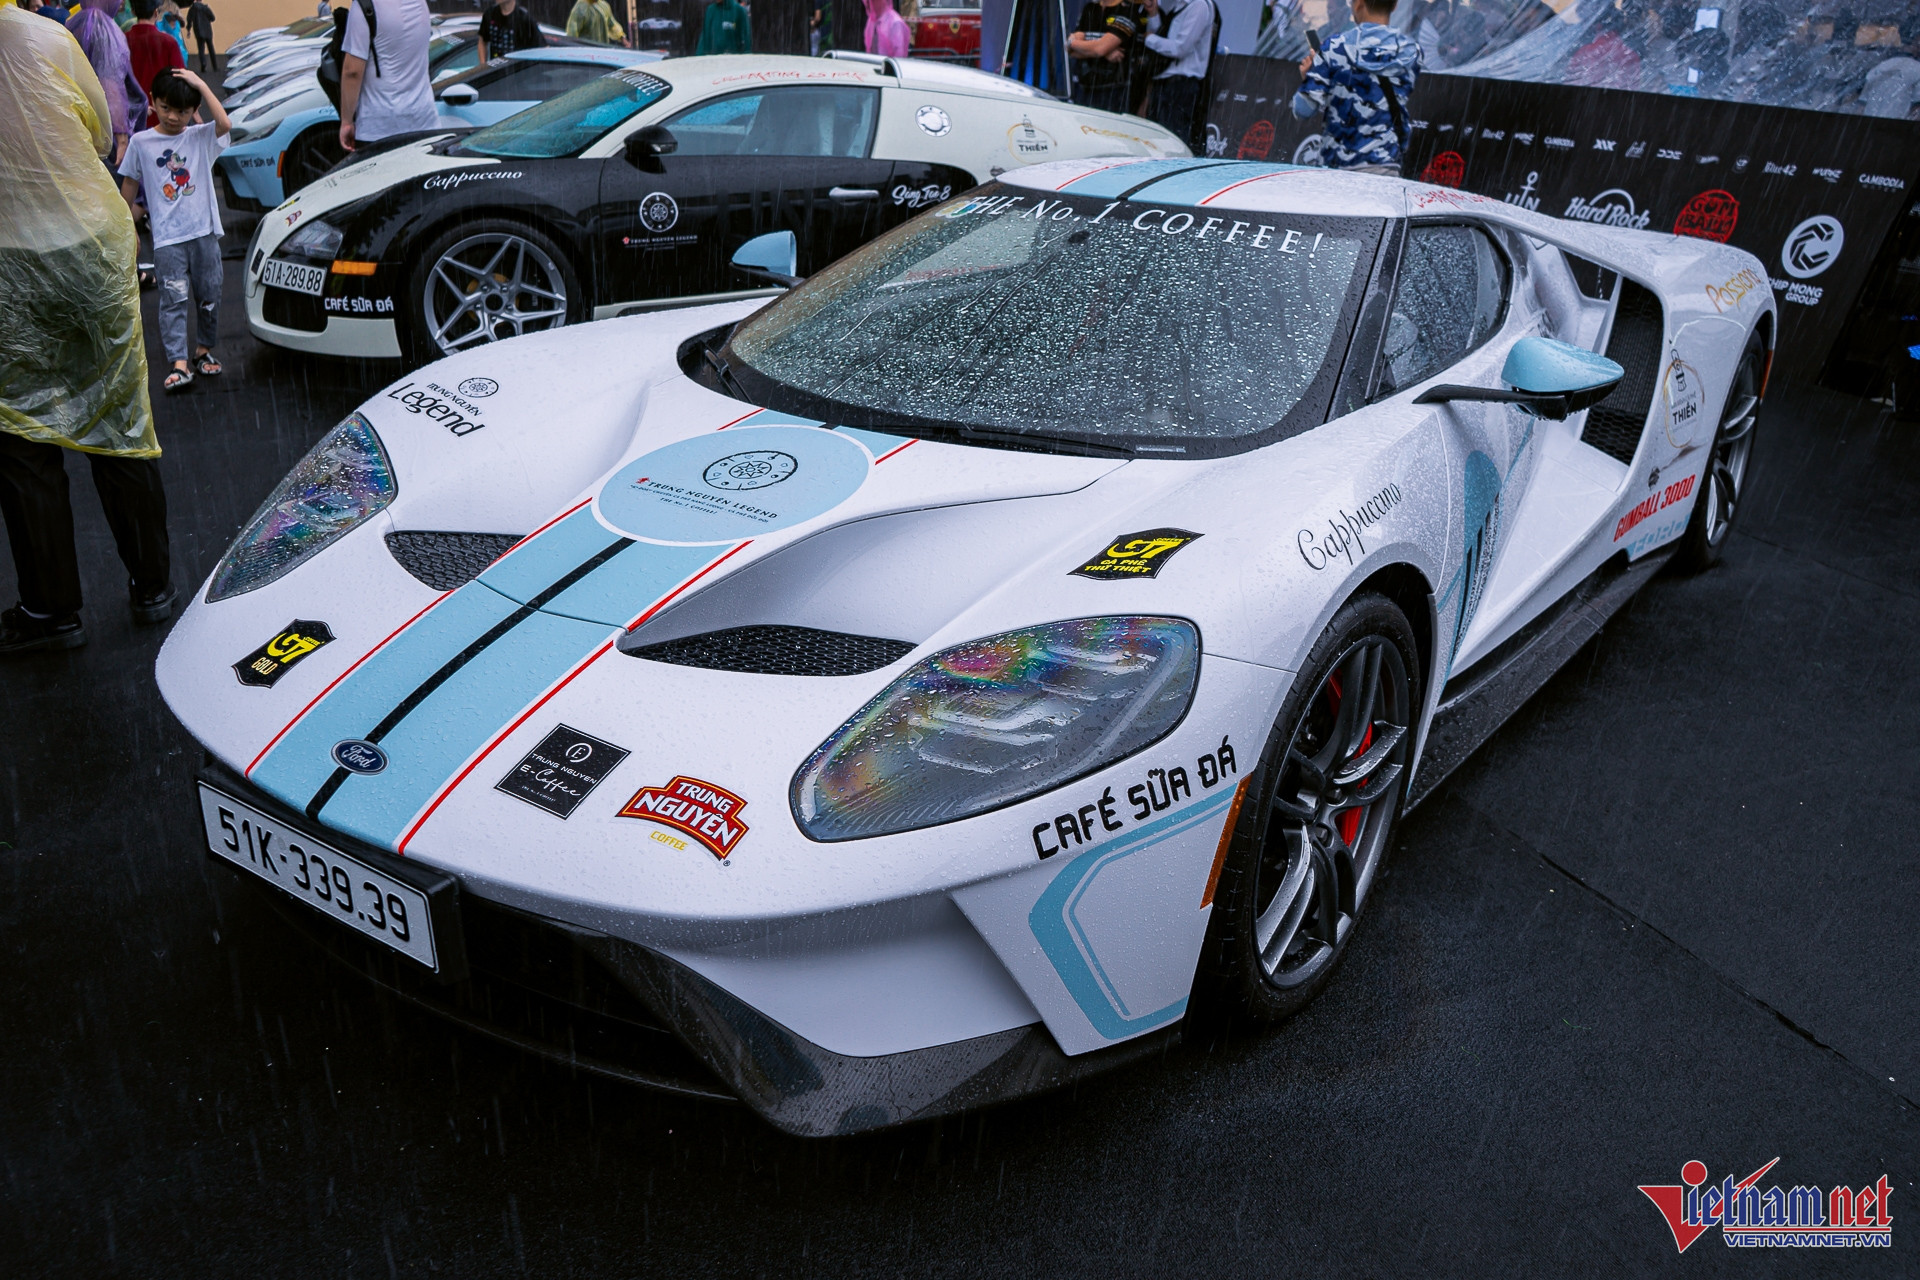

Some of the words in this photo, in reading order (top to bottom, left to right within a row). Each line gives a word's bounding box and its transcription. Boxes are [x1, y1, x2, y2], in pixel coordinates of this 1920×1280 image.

[423, 171, 523, 190] Cappuccino
[958, 196, 1025, 215] THE
[1133, 208, 1324, 259] COFFEE!
[1564, 196, 1613, 223] Hard
[1605, 204, 1650, 229] Rock
[264, 260, 323, 292] 51A-289.88
[1788, 281, 1824, 298] MONG
[324, 296, 350, 311] CAFÉ
[375, 296, 395, 312] ĐÁ
[1785, 292, 1820, 306] GROUP
[387, 382, 486, 438] Legend
[648, 481, 685, 493] TRUNG
[732, 502, 778, 519] LEGEND
[1660, 474, 1696, 510] 3000
[1298, 483, 1402, 571] Cappuccino
[341, 744, 377, 768] Ford
[675, 781, 735, 814] TRUNG
[1032, 786, 1124, 861] CAFÉ
[1197, 734, 1238, 789] ĐÁ
[633, 791, 739, 847] NGUYÊN
[649, 829, 689, 852] COFFEE
[217, 805, 411, 943] 51K-339.39
